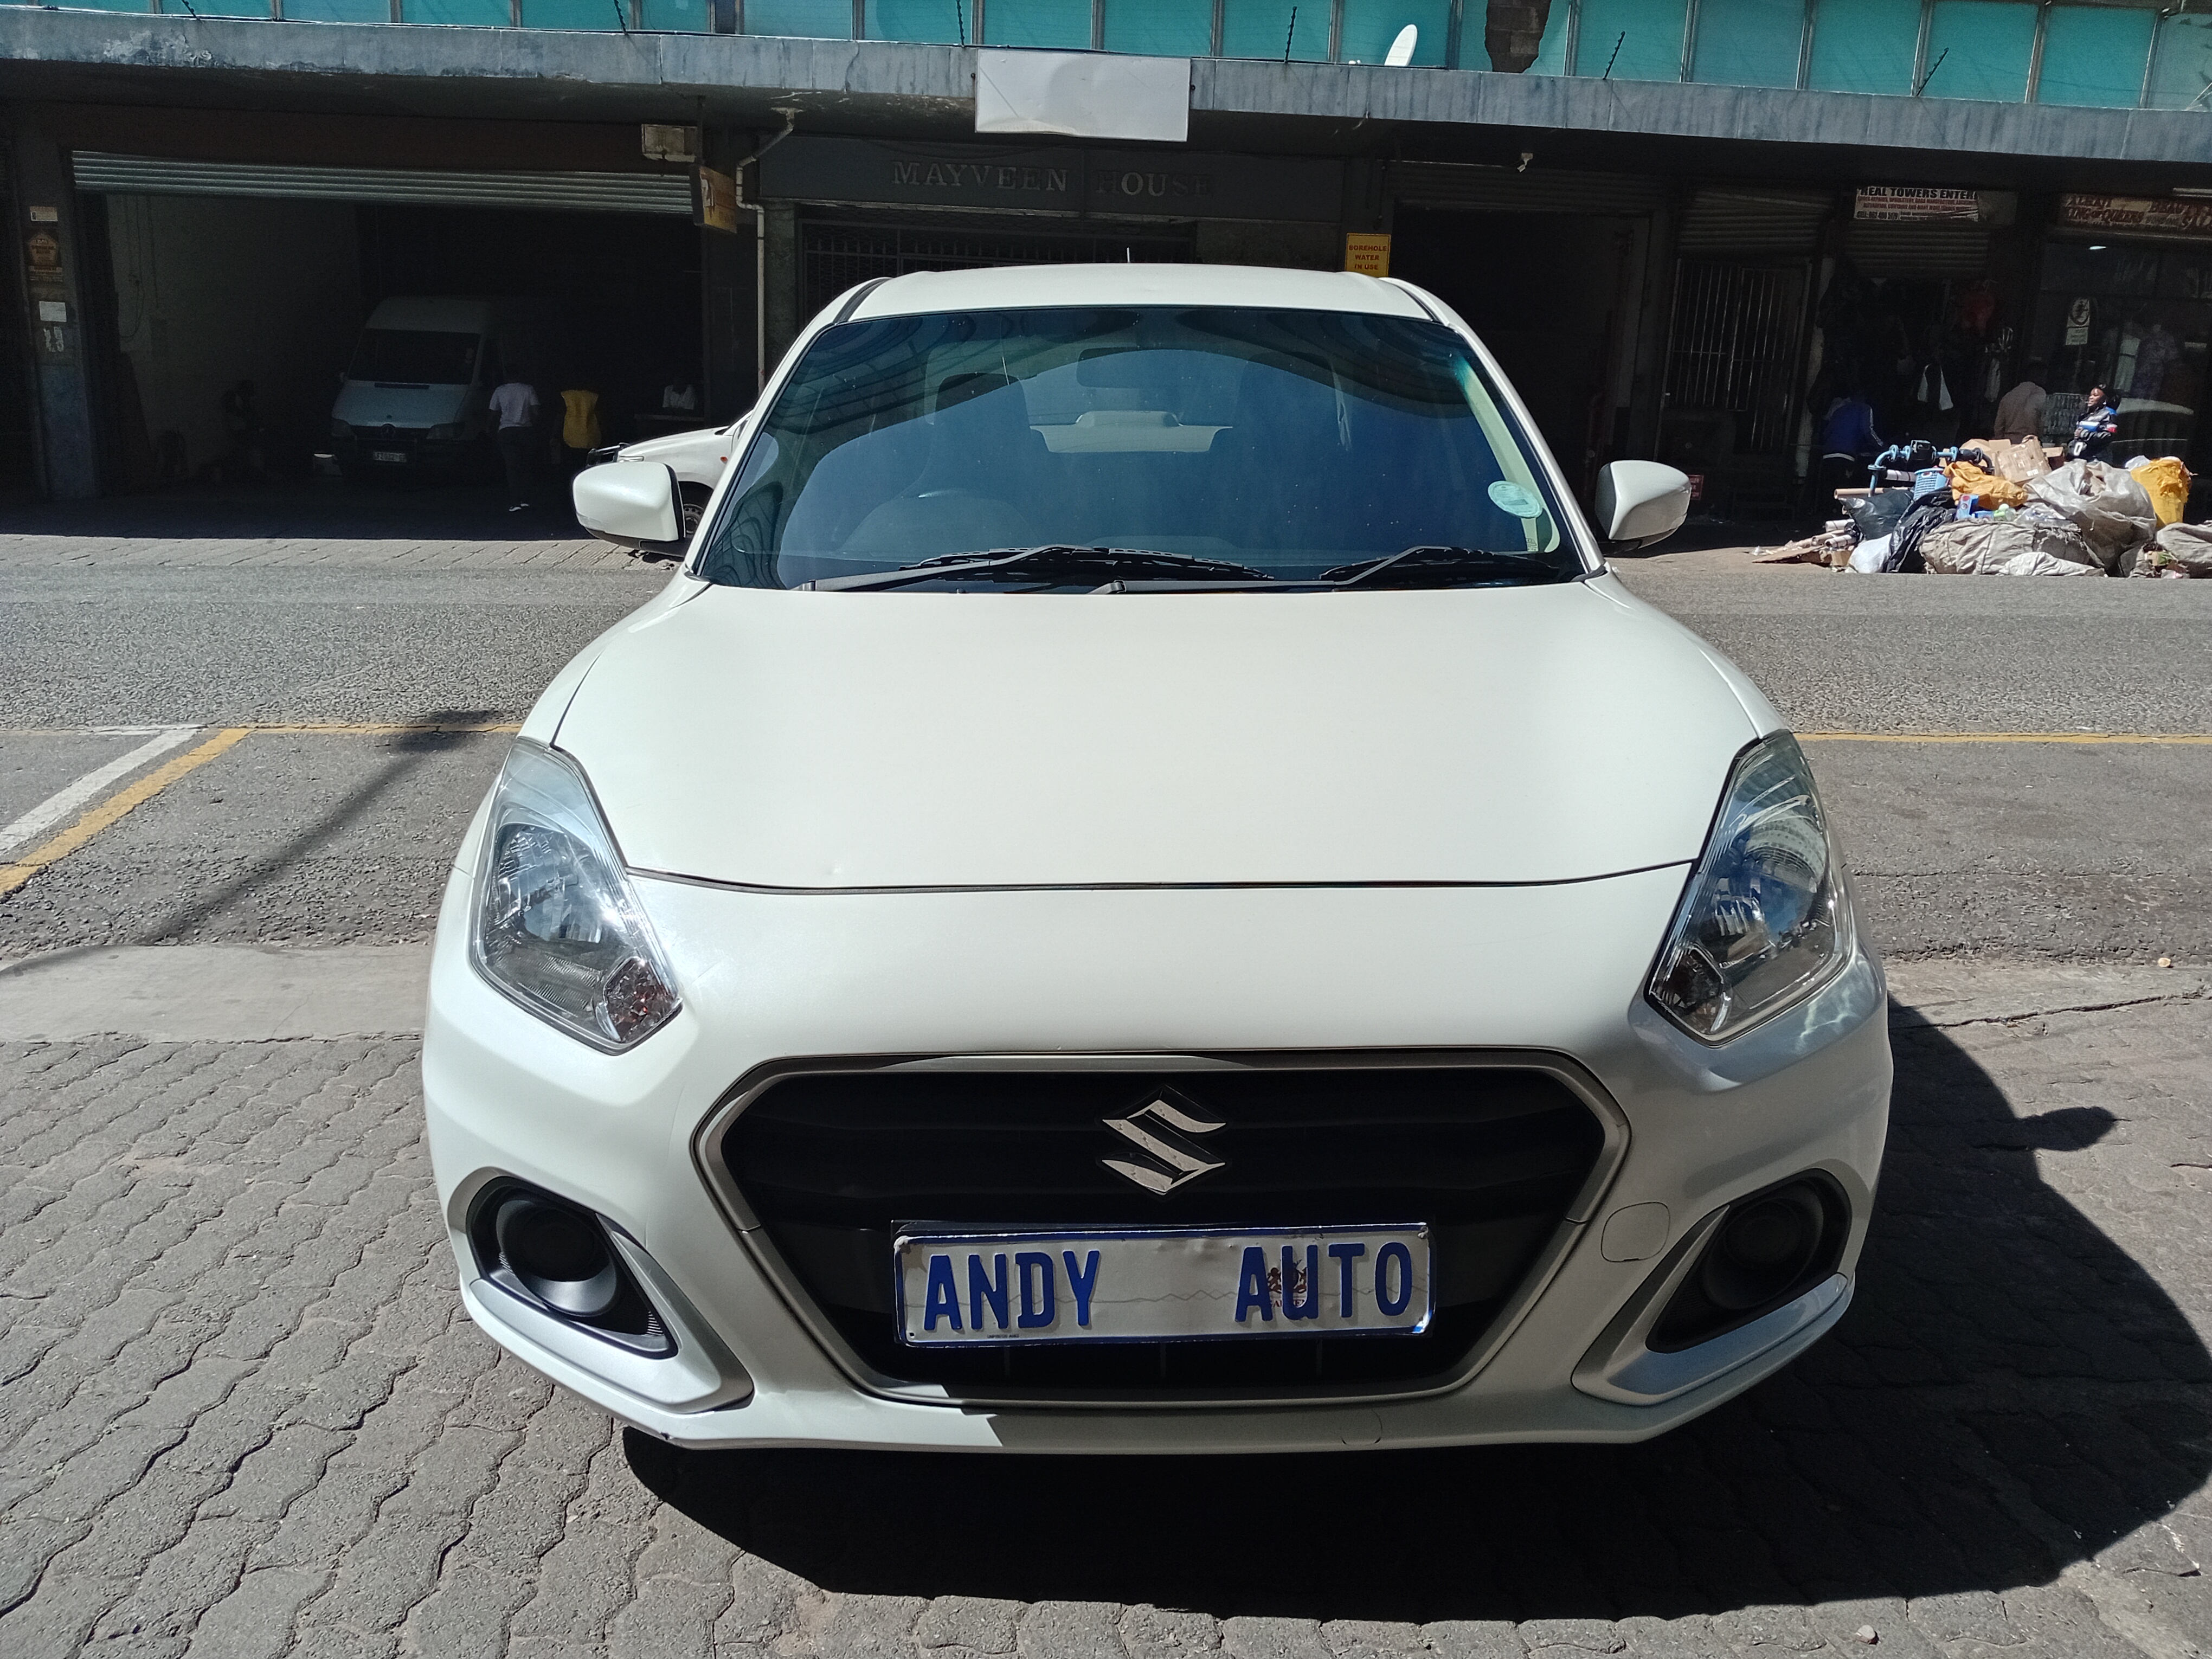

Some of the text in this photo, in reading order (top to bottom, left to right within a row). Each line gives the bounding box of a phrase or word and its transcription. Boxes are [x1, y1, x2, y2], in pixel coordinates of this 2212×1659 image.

[892, 162, 1215, 197] MAYVEEN HOUSE
[1891, 188, 1938, 198] TOWERS
[923, 1241, 1413, 1331] ANDY AUTO
